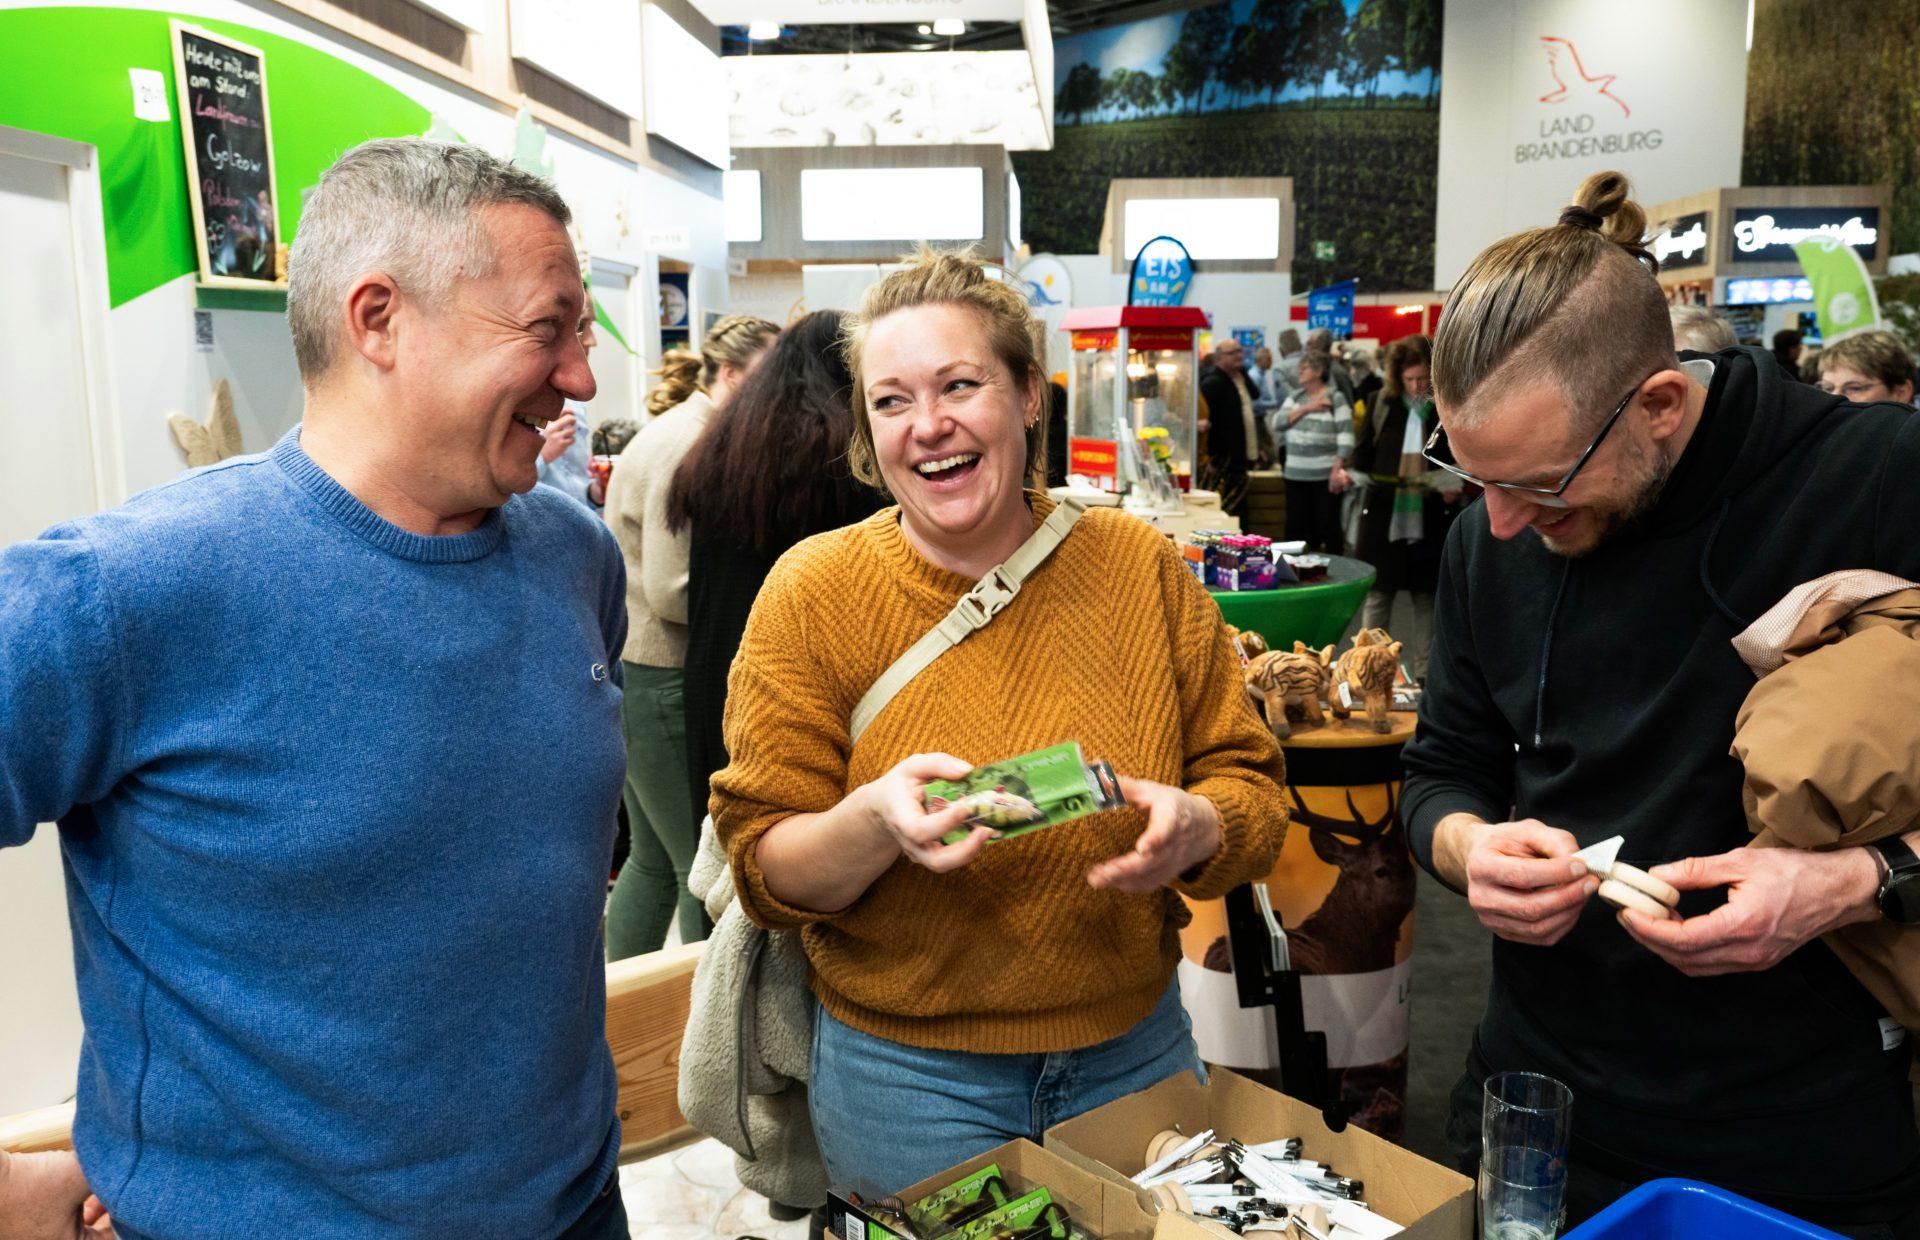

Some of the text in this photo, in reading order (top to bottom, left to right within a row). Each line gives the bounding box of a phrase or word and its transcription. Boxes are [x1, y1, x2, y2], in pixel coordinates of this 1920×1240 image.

[189, 75, 212, 90] am
[1540, 113, 1594, 139] LAND
[1515, 129, 1663, 164] BRANDENBURG
[1145, 257, 1181, 280] EIS
